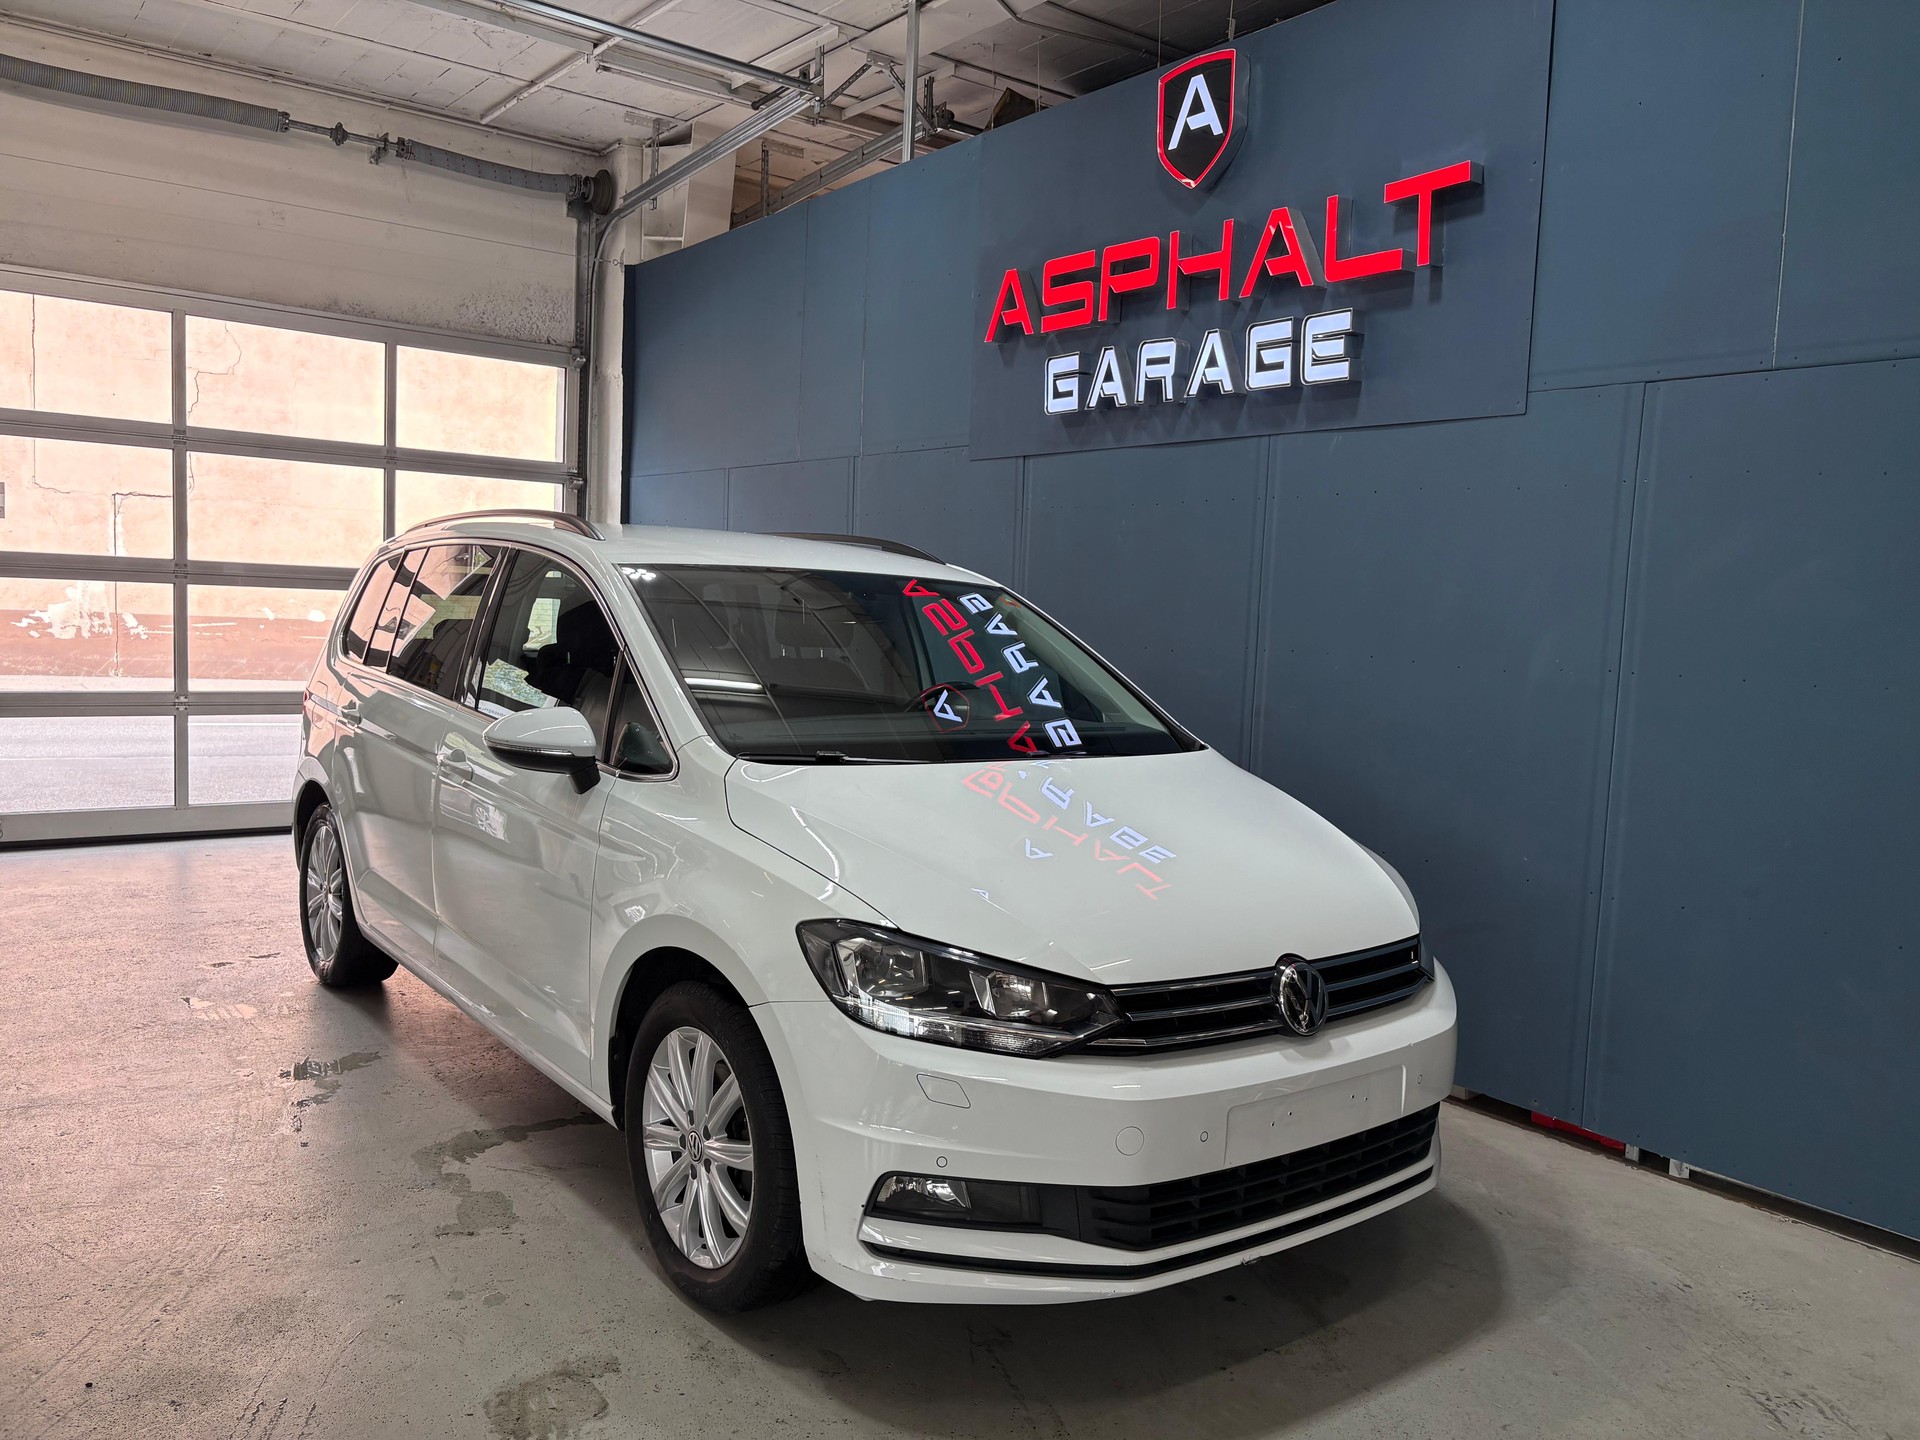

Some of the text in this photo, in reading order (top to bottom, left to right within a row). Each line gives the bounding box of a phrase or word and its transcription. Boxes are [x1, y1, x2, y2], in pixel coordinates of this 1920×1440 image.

[1168, 74, 1223, 150] A
[984, 160, 1472, 343] ASPHALT
[1044, 307, 1354, 416] GARAGE
